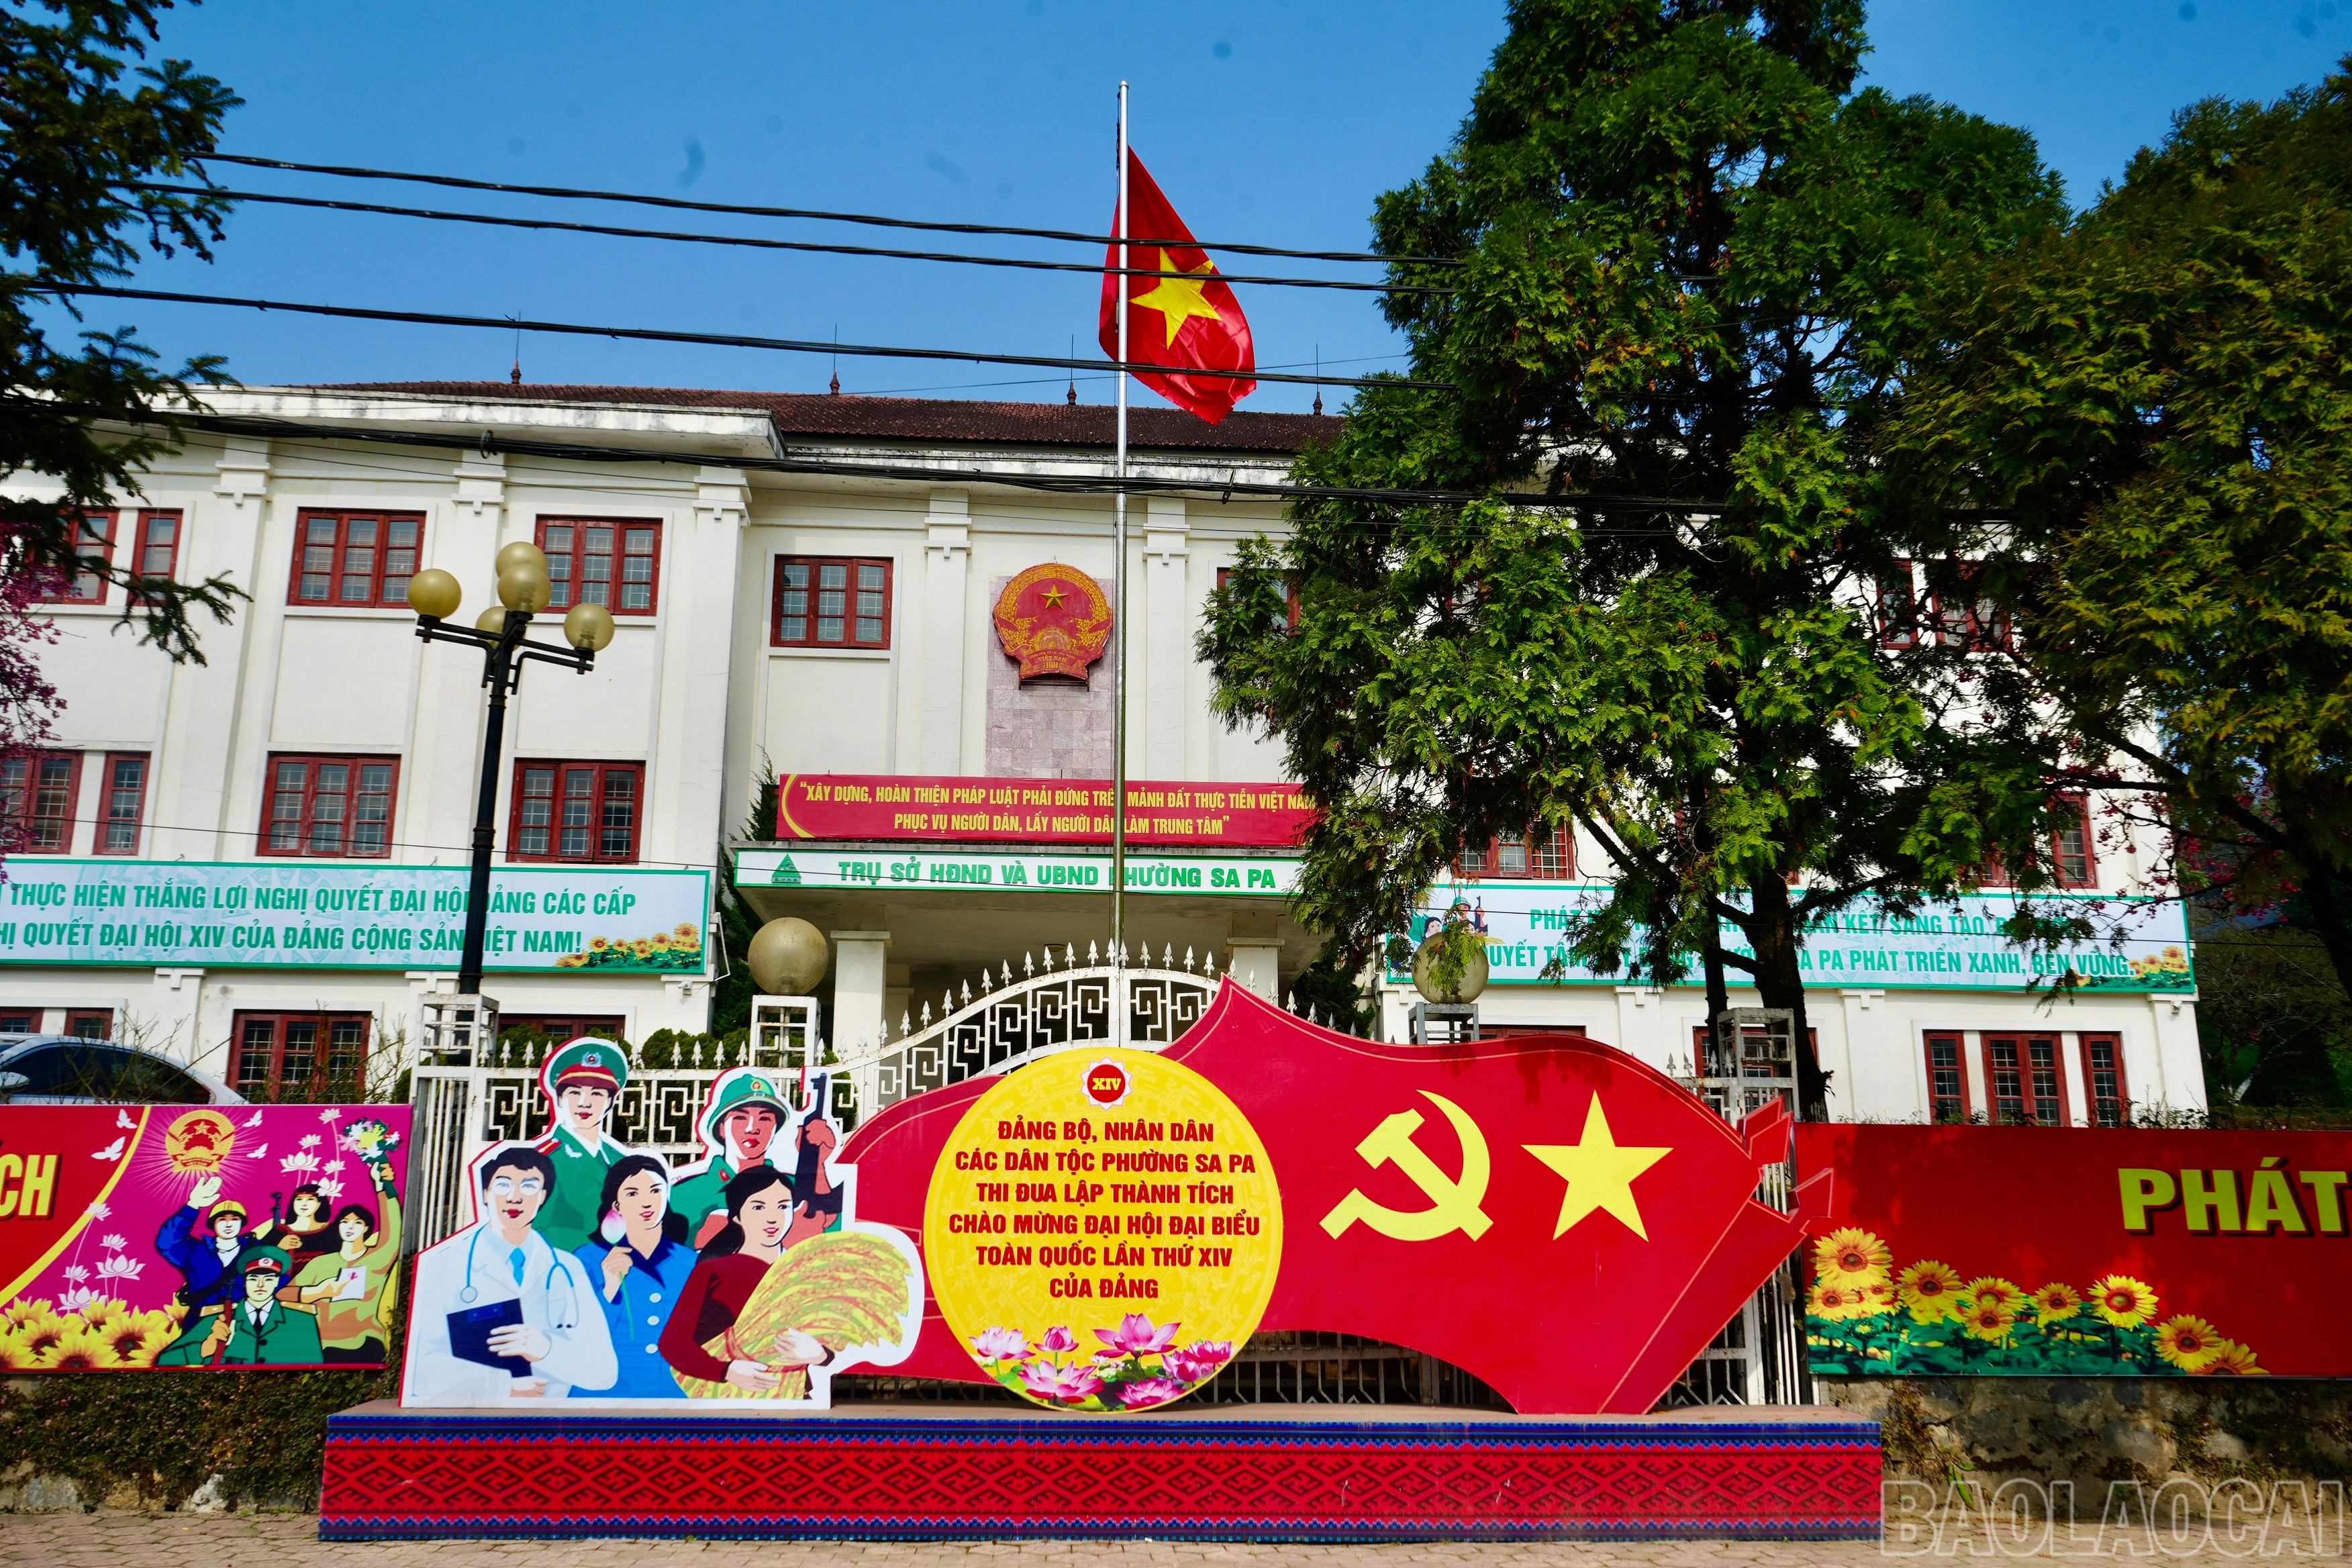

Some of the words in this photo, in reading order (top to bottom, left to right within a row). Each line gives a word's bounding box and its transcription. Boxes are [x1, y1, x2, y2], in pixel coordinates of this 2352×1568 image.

[834, 785, 872, 805] DỰNG,
[876, 783, 910, 803] HOÀN
[914, 784, 950, 807] THIỆN
[952, 785, 986, 804] PHÁP
[989, 785, 1020, 808] LUẬT
[1022, 785, 1052, 805] PHẢI
[1055, 787, 1089, 806] ĐỨNG
[1092, 791, 1115, 807] TRÊ
[1127, 787, 1165, 807] MẢNH
[1167, 787, 1191, 808] ĐẤT
[1193, 791, 1225, 812] THỰC
[1228, 788, 1256, 809] TIỄN
[1259, 791, 1285, 813] VIỆT
[894, 814, 928, 833] PHỤC
[932, 814, 948, 834] VỤ
[951, 811, 989, 831] NGƯỜI
[993, 812, 1022, 834] DÂN,
[1026, 813, 1049, 832] LẤY
[1052, 813, 1090, 833] NGƯỜI
[1124, 814, 1149, 834] LÀM
[1153, 818, 1193, 834] TRUNG
[1196, 815, 1230, 835] TÂM”
[838, 861, 881, 885] TRỤ
[891, 854, 921, 882] SỞ
[930, 863, 992, 884] HĐND
[1001, 860, 1028, 884] VÀ
[1037, 865, 1099, 885] UBND
[1210, 867, 1240, 887] SA
[1247, 869, 1276, 888] PA
[10, 881, 67, 911] THỰC
[73, 880, 126, 912] HIỆN
[134, 877, 207, 909] THẮNG
[213, 885, 248, 914] LỢI
[254, 887, 308, 915] NGHỊ
[315, 884, 384, 913] QUYẾT
[390, 889, 426, 916] ĐẠI
[433, 885, 470, 918] HỘI
[487, 884, 536, 914] ẢNG
[543, 888, 586, 915] CÁC
[593, 885, 636, 915] CẤP
[23, 918, 94, 948] QUYẾT
[99, 924, 138, 951] ĐẠI
[144, 920, 182, 952] HỘI
[188, 925, 226, 948] XIV
[232, 919, 276, 948] CỦA
[283, 920, 344, 950] ĐẢNG
[351, 923, 412, 955] CỘNG
[418, 921, 466, 951] SẢN
[485, 925, 518, 957] IỆT
[523, 930, 582, 953] NAM!
[1947, 916, 1990, 941] TẠO,
[1482, 938, 1538, 967] UYẾT
[1818, 949, 1845, 971] PA
[1849, 946, 1900, 971] PHÁT
[1904, 942, 1963, 973] TRIỂN
[1967, 952, 2027, 975] XANH,
[1092, 1078, 1122, 1091] XIV
[997, 1114, 1057, 1140] ĐẢNG
[1063, 1118, 1097, 1144] BỘ,
[1104, 1118, 1163, 1141] NHÂN
[1170, 1119, 1214, 1142] DÂN
[955, 1147, 997, 1171] CÁC
[1005, 1148, 1048, 1171] DÂN
[1055, 1148, 1095, 1175] TỘC
[1101, 1148, 1188, 1173] PHƯỜNG
[1195, 1153, 1222, 1173] SA
[1229, 1154, 1256, 1173] PA
[976, 1183, 1009, 1202] THI
[1015, 1183, 1057, 1203] ĐUA
[1064, 1179, 1104, 1207] LẬP
[1110, 1180, 1180, 1204] THÀNH
[1186, 1181, 1234, 1204] TÍCH
[2118, 1157, 2347, 1232] PHÁT
[949, 1210, 1006, 1234] CHÀO
[1014, 1210, 1078, 1234] MỪNG
[1084, 1215, 1120, 1238] ĐẠI
[1127, 1212, 1163, 1239] HỘI
[1169, 1216, 1205, 1240] ĐẠI
[1212, 1208, 1260, 1236] BIỂU
[975, 1242, 1032, 1266] TOÀN
[1039, 1240, 1096, 1268] QUỐC
[1103, 1242, 1144, 1267] LẦN
[1150, 1243, 1194, 1267] THỨ
[1198, 1248, 1232, 1267] XIV
[1049, 1272, 1093, 1298] CỦA
[1099, 1272, 1159, 1299] ĐẢNG
